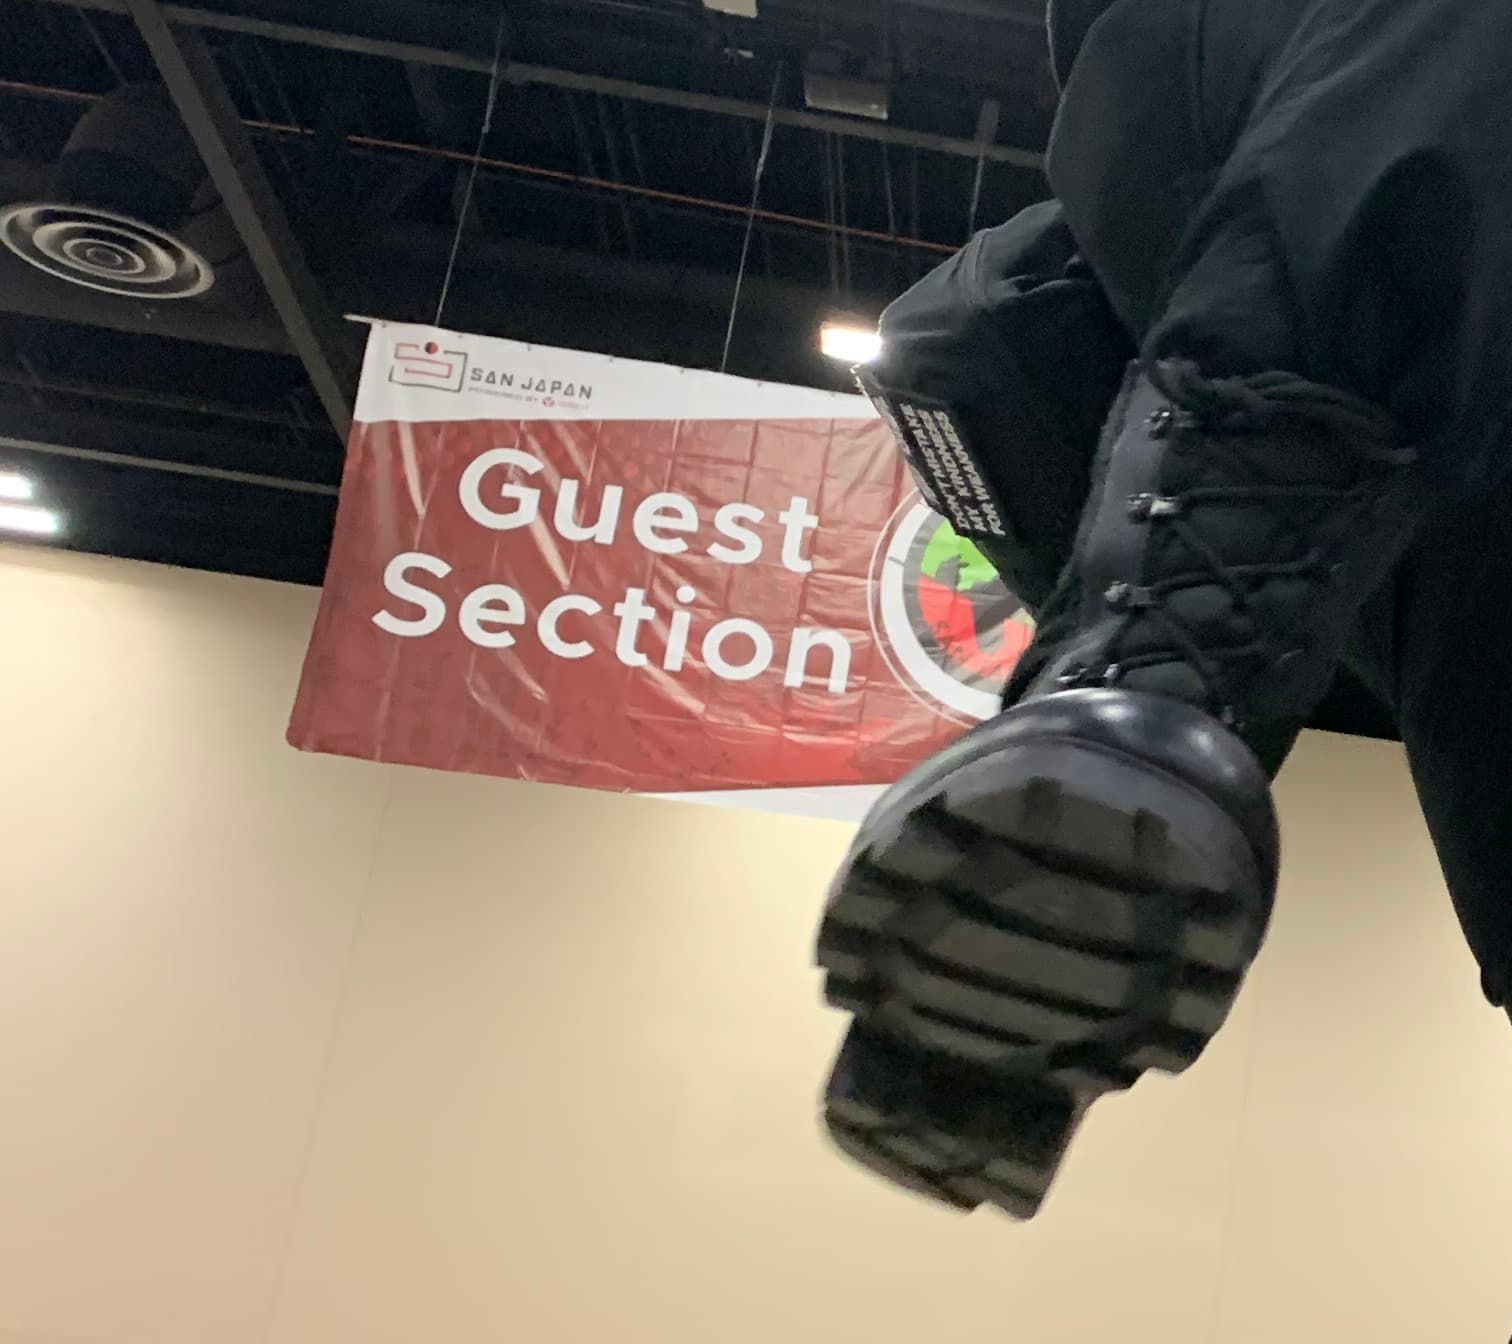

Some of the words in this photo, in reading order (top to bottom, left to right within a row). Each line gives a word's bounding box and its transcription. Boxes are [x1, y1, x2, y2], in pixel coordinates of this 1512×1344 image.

[470, 367, 514, 387] SAN
[521, 377, 593, 401] JAPAN
[899, 402, 946, 478] MISTAKE
[917, 408, 971, 497] KINDNESS
[932, 409, 991, 501] WEAKNESS
[458, 448, 819, 573] Guest
[963, 505, 988, 532] MY
[980, 502, 1006, 536] FOR
[371, 552, 852, 694] Section
